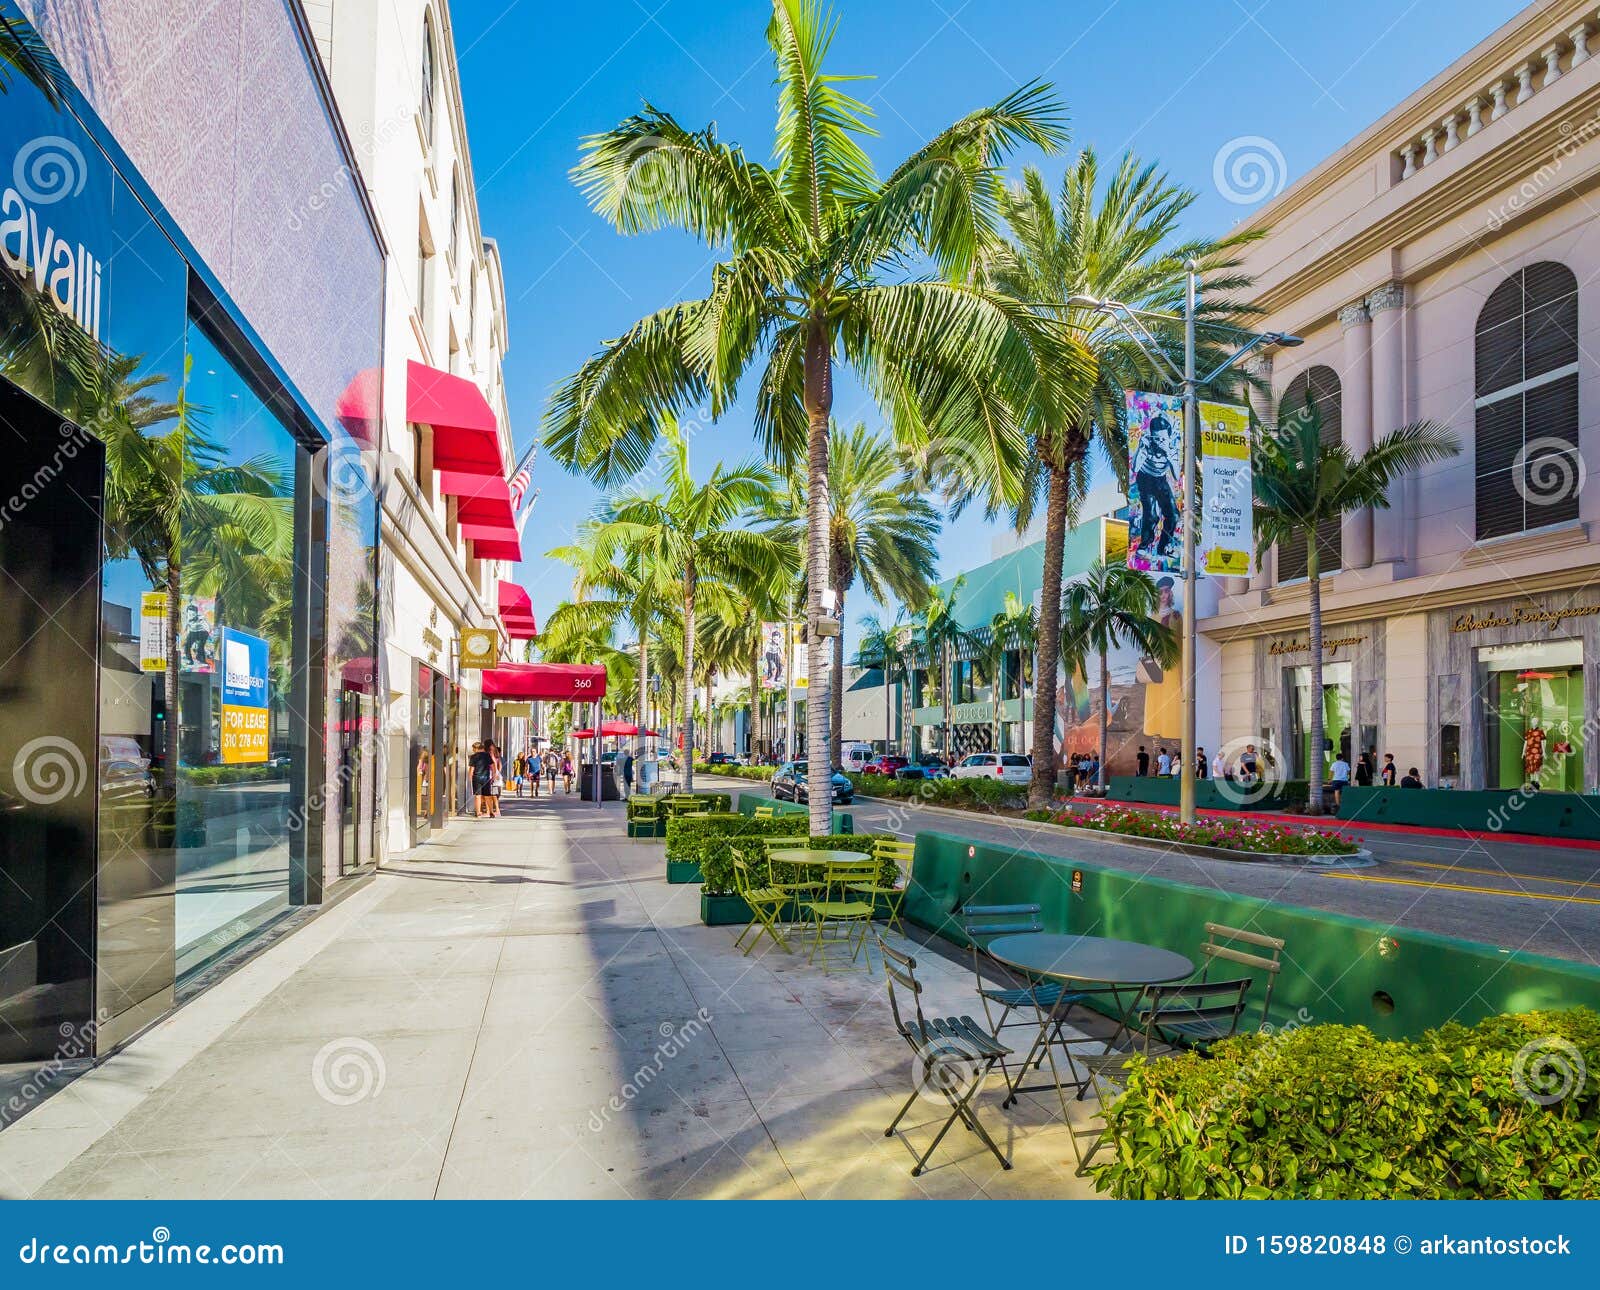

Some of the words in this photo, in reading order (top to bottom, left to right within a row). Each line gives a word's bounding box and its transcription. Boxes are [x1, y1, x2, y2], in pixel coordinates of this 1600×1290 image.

[0, 187, 101, 341] avalli
[1205, 431, 1246, 446] SUMMER
[1213, 467, 1238, 477] Kickoff
[1211, 505, 1241, 517] Ongoing
[1449, 612, 1511, 632] Salvatore
[1512, 602, 1600, 631] Ferragamo
[574, 678, 592, 688] 360
[225, 711, 244, 728] FOR
[245, 712, 266, 729] LEASE
[957, 705, 989, 720] GUCCI
[224, 733, 237, 748] 310
[253, 734, 266, 747] 4747
